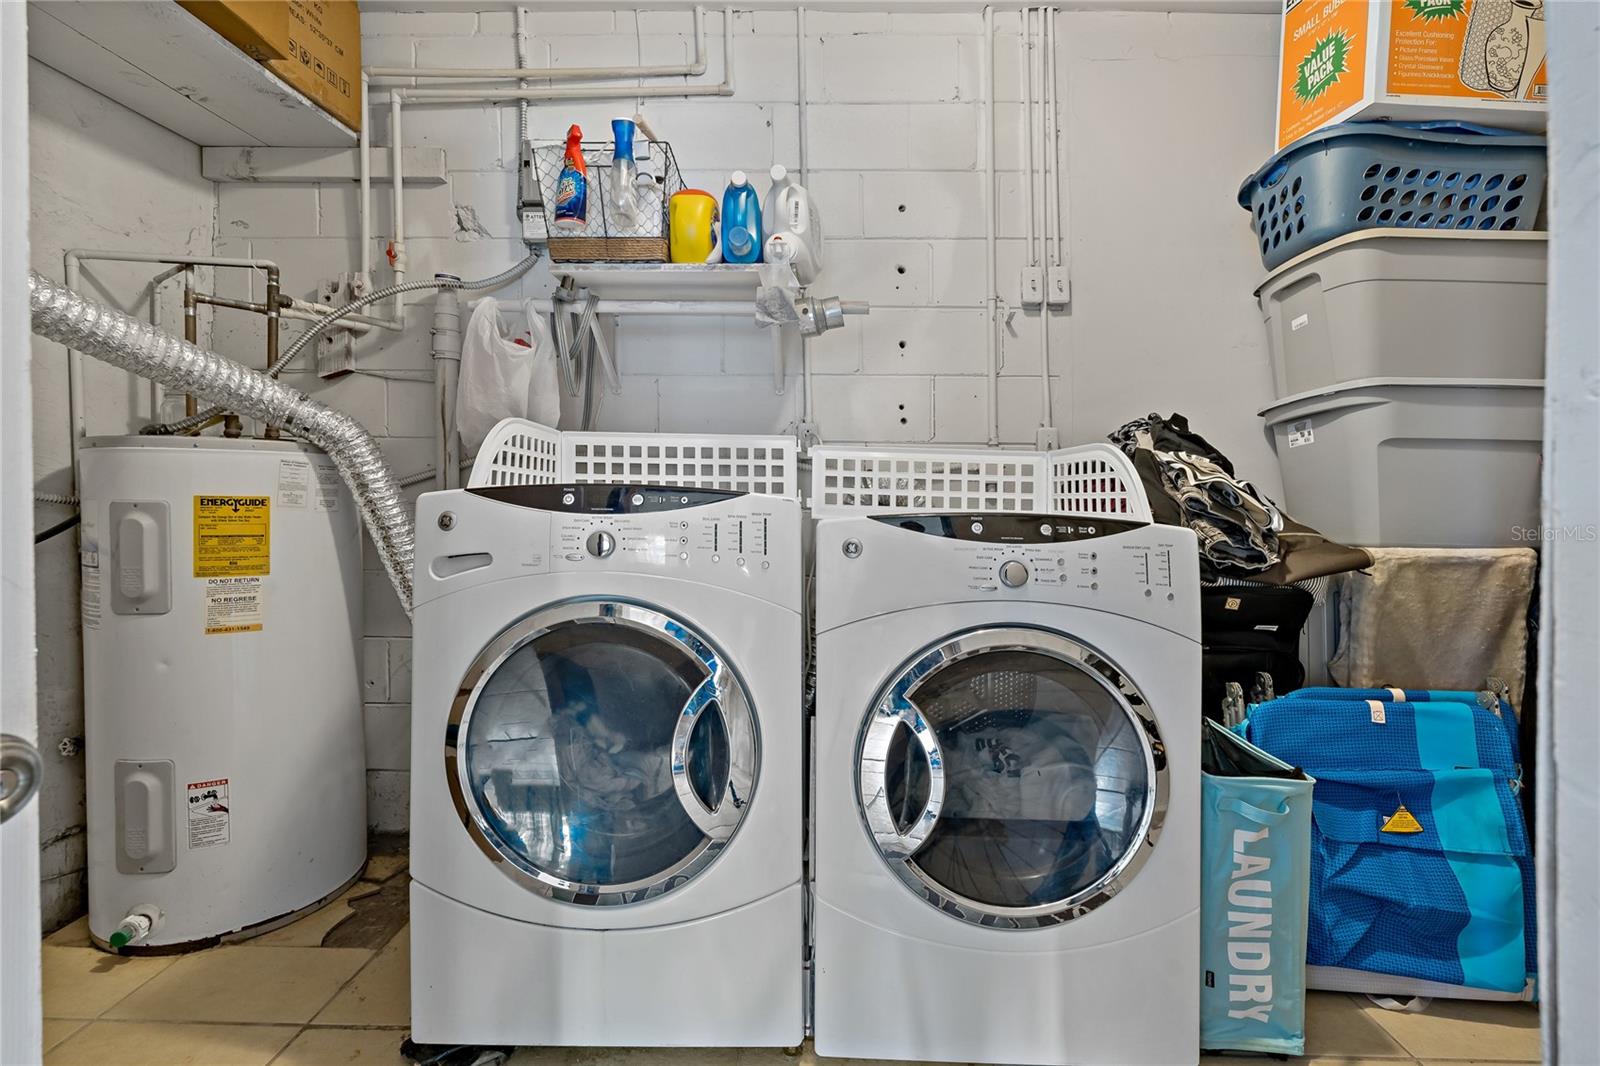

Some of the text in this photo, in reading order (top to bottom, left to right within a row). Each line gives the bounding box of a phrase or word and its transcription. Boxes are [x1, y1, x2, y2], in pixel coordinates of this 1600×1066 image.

[1292, 14, 1320, 42] SMALL
[1322, 0, 1346, 18] BUB
[1422, 31, 1455, 40] Cushioning
[1304, 41, 1336, 78] VALUE
[1307, 57, 1335, 90] PACK
[200, 498, 268, 510] ENERGYGUIDE
[197, 780, 227, 788] DANGER
[1228, 827, 1274, 1024] LAUNDRY
